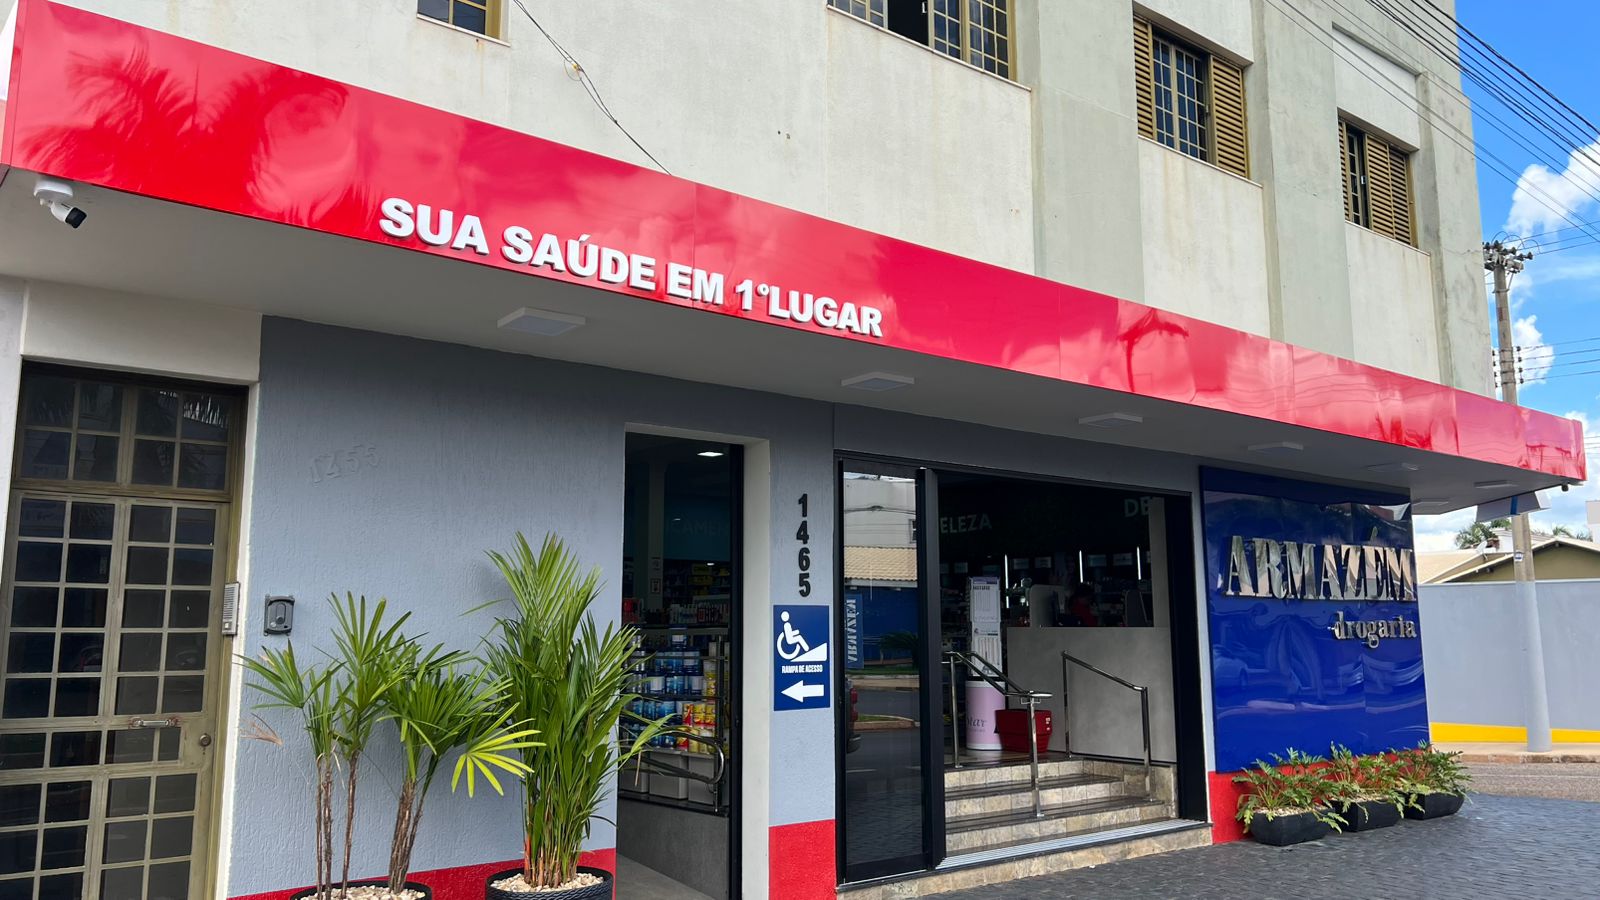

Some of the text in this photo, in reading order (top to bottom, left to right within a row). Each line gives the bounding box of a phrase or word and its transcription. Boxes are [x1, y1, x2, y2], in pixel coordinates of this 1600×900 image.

[379, 197, 489, 255] SUA
[502, 226, 656, 291] SAÚDE
[666, 262, 724, 304] EM
[796, 493, 811, 597] 1465
[940, 512, 992, 533] ELEZA
[1226, 526, 1416, 600] ARMAZÉM
[1334, 611, 1417, 648] drogaria
[781, 664, 823, 674] RAMPA DE ACESSO
